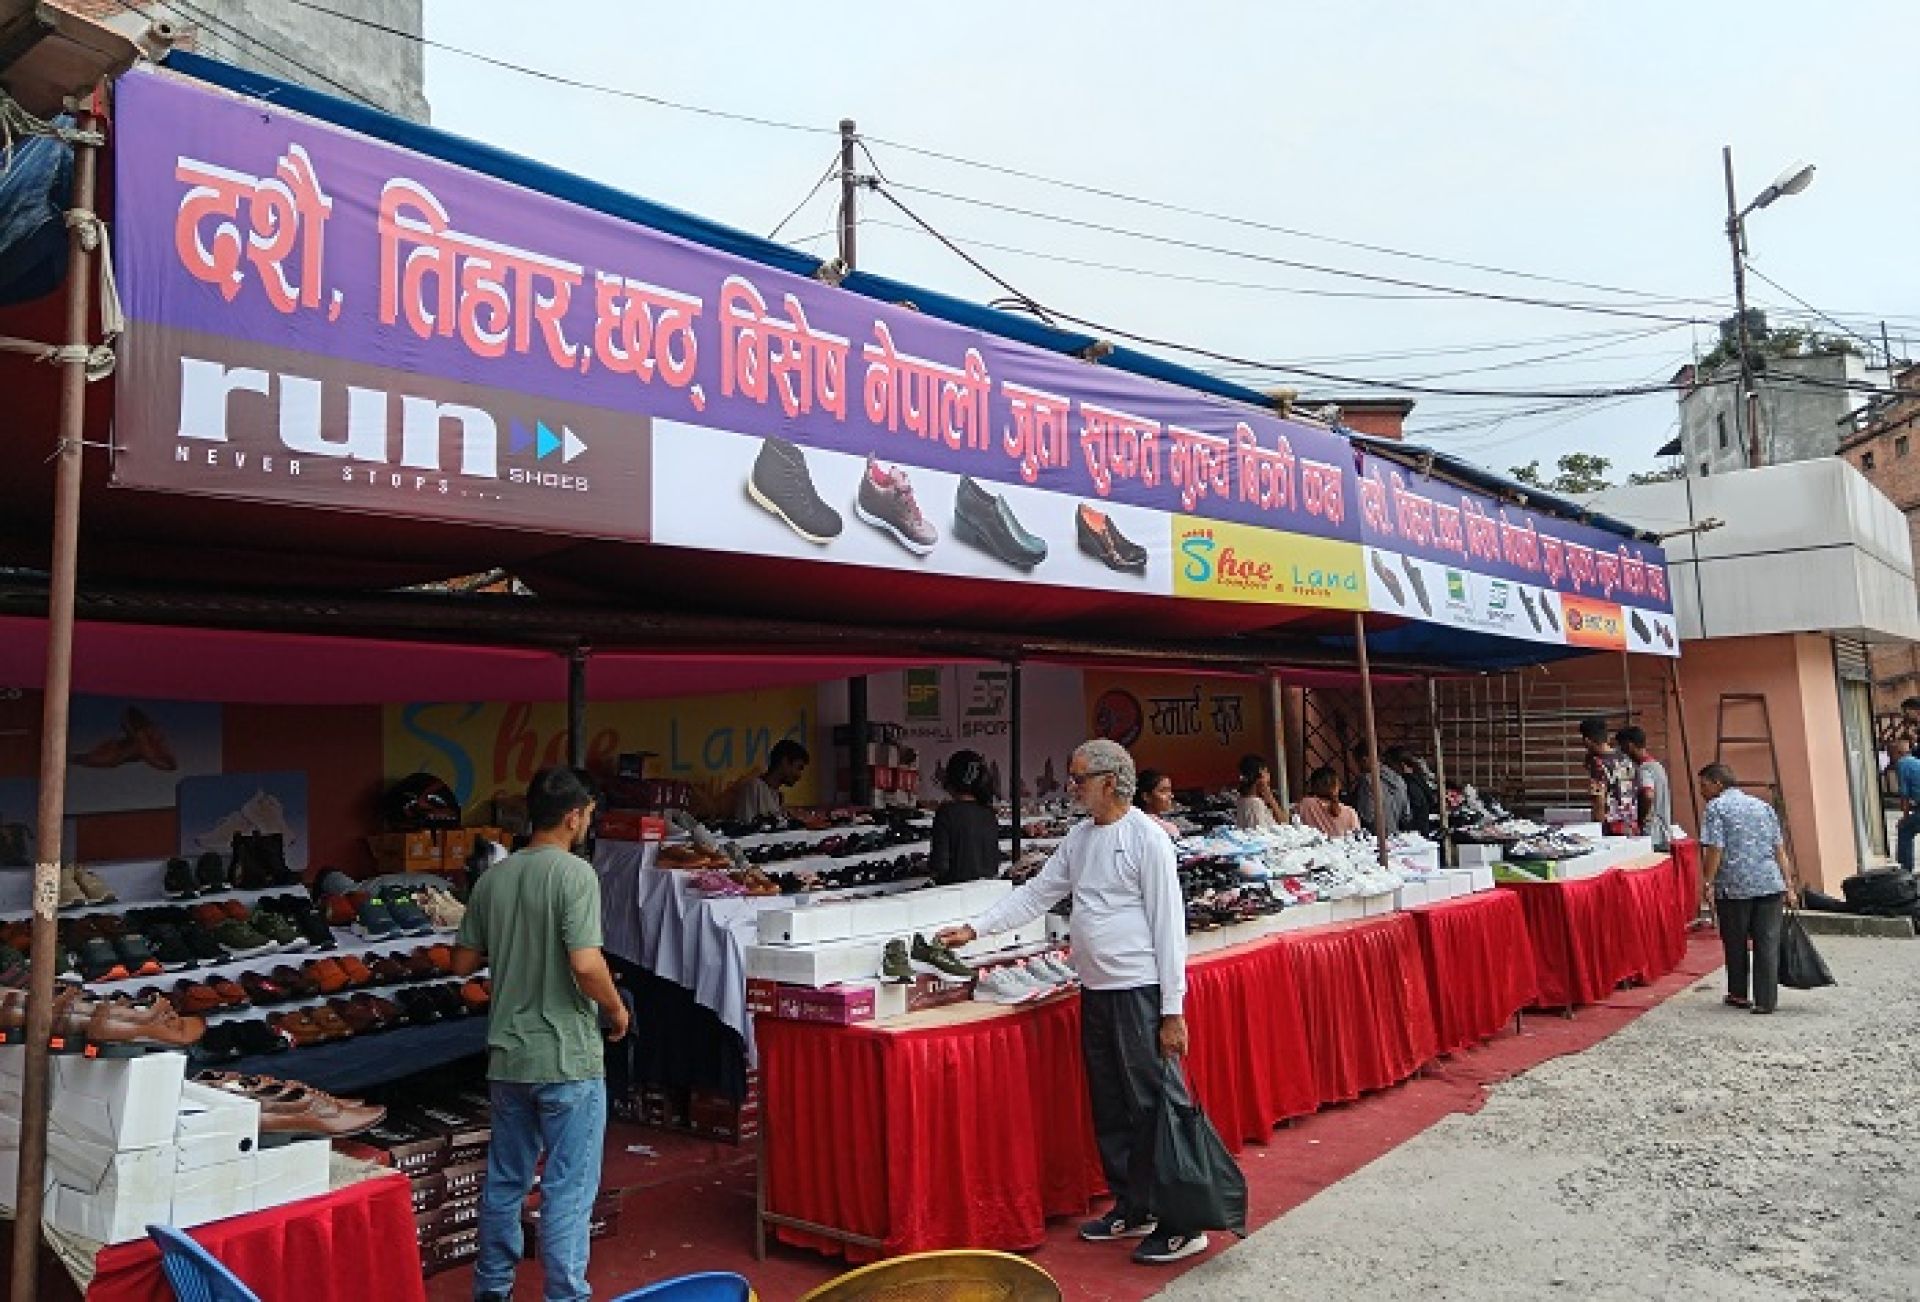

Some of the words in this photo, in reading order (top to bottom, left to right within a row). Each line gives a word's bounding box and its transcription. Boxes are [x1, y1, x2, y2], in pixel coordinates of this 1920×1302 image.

[177, 355, 499, 480] run
[719, 274, 851, 423] बिसेष
[863, 320, 992, 452] नेपाली
[1001, 380, 1071, 482] जुता
[176, 445, 300, 477] NEVER
[1181, 537, 1274, 583] Shoe
[1292, 562, 1359, 592] Land
